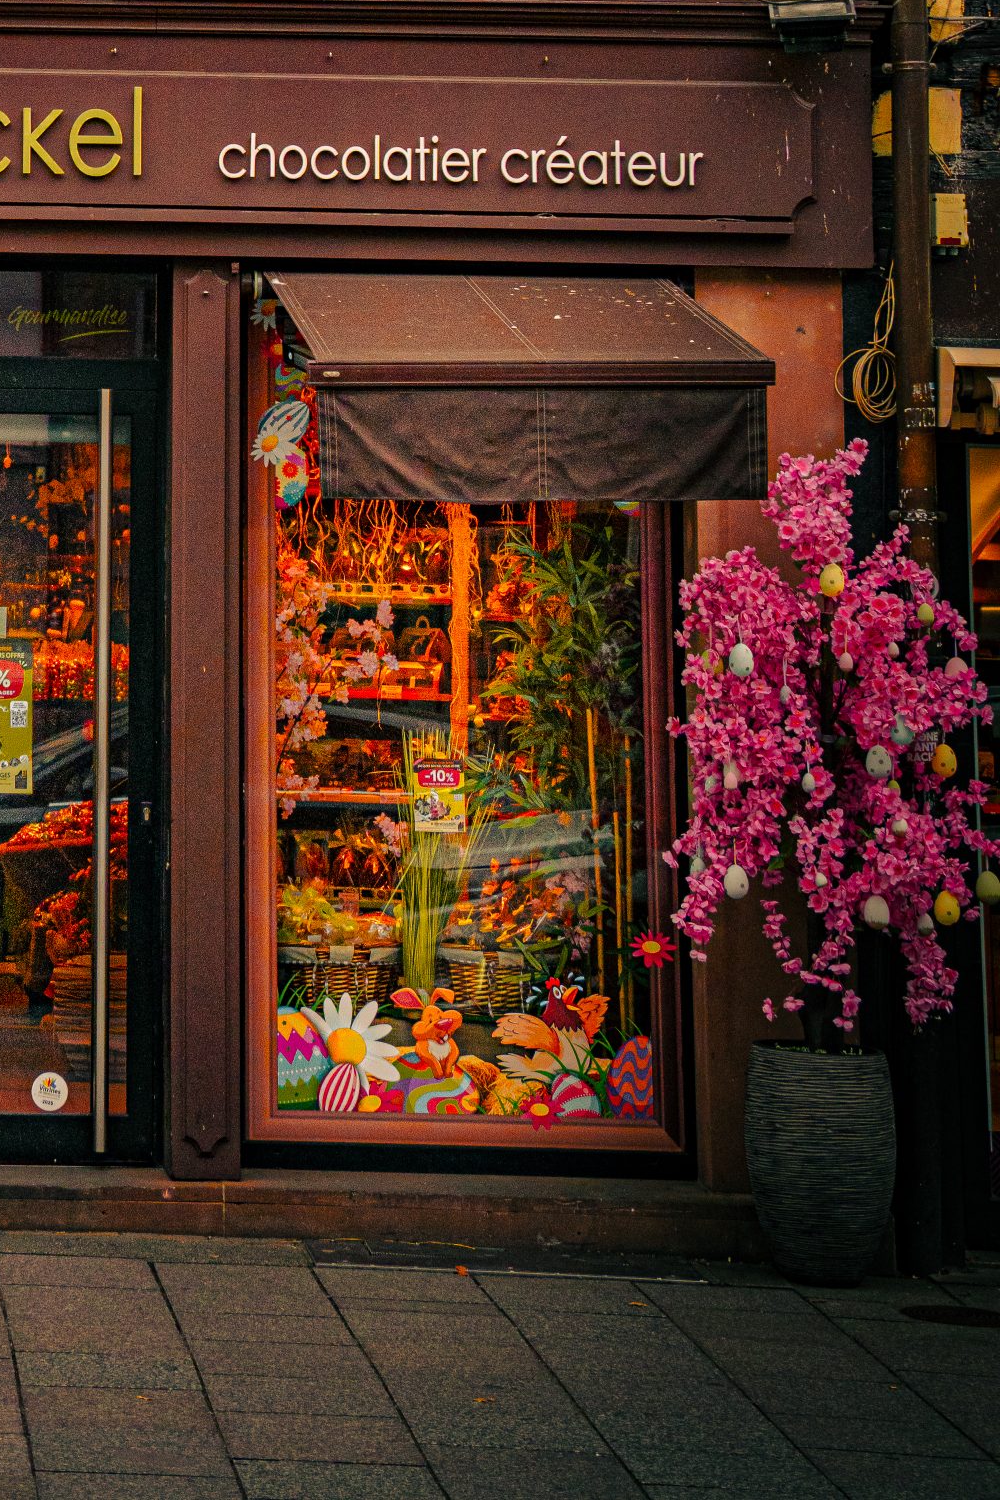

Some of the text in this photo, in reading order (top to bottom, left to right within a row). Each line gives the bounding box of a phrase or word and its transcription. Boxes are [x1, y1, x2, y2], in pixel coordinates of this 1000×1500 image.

[218, 132, 705, 187] chocolatier créateur
[7, 302, 128, 332] Gourmandise
[424, 769, 455, 782] -10%
